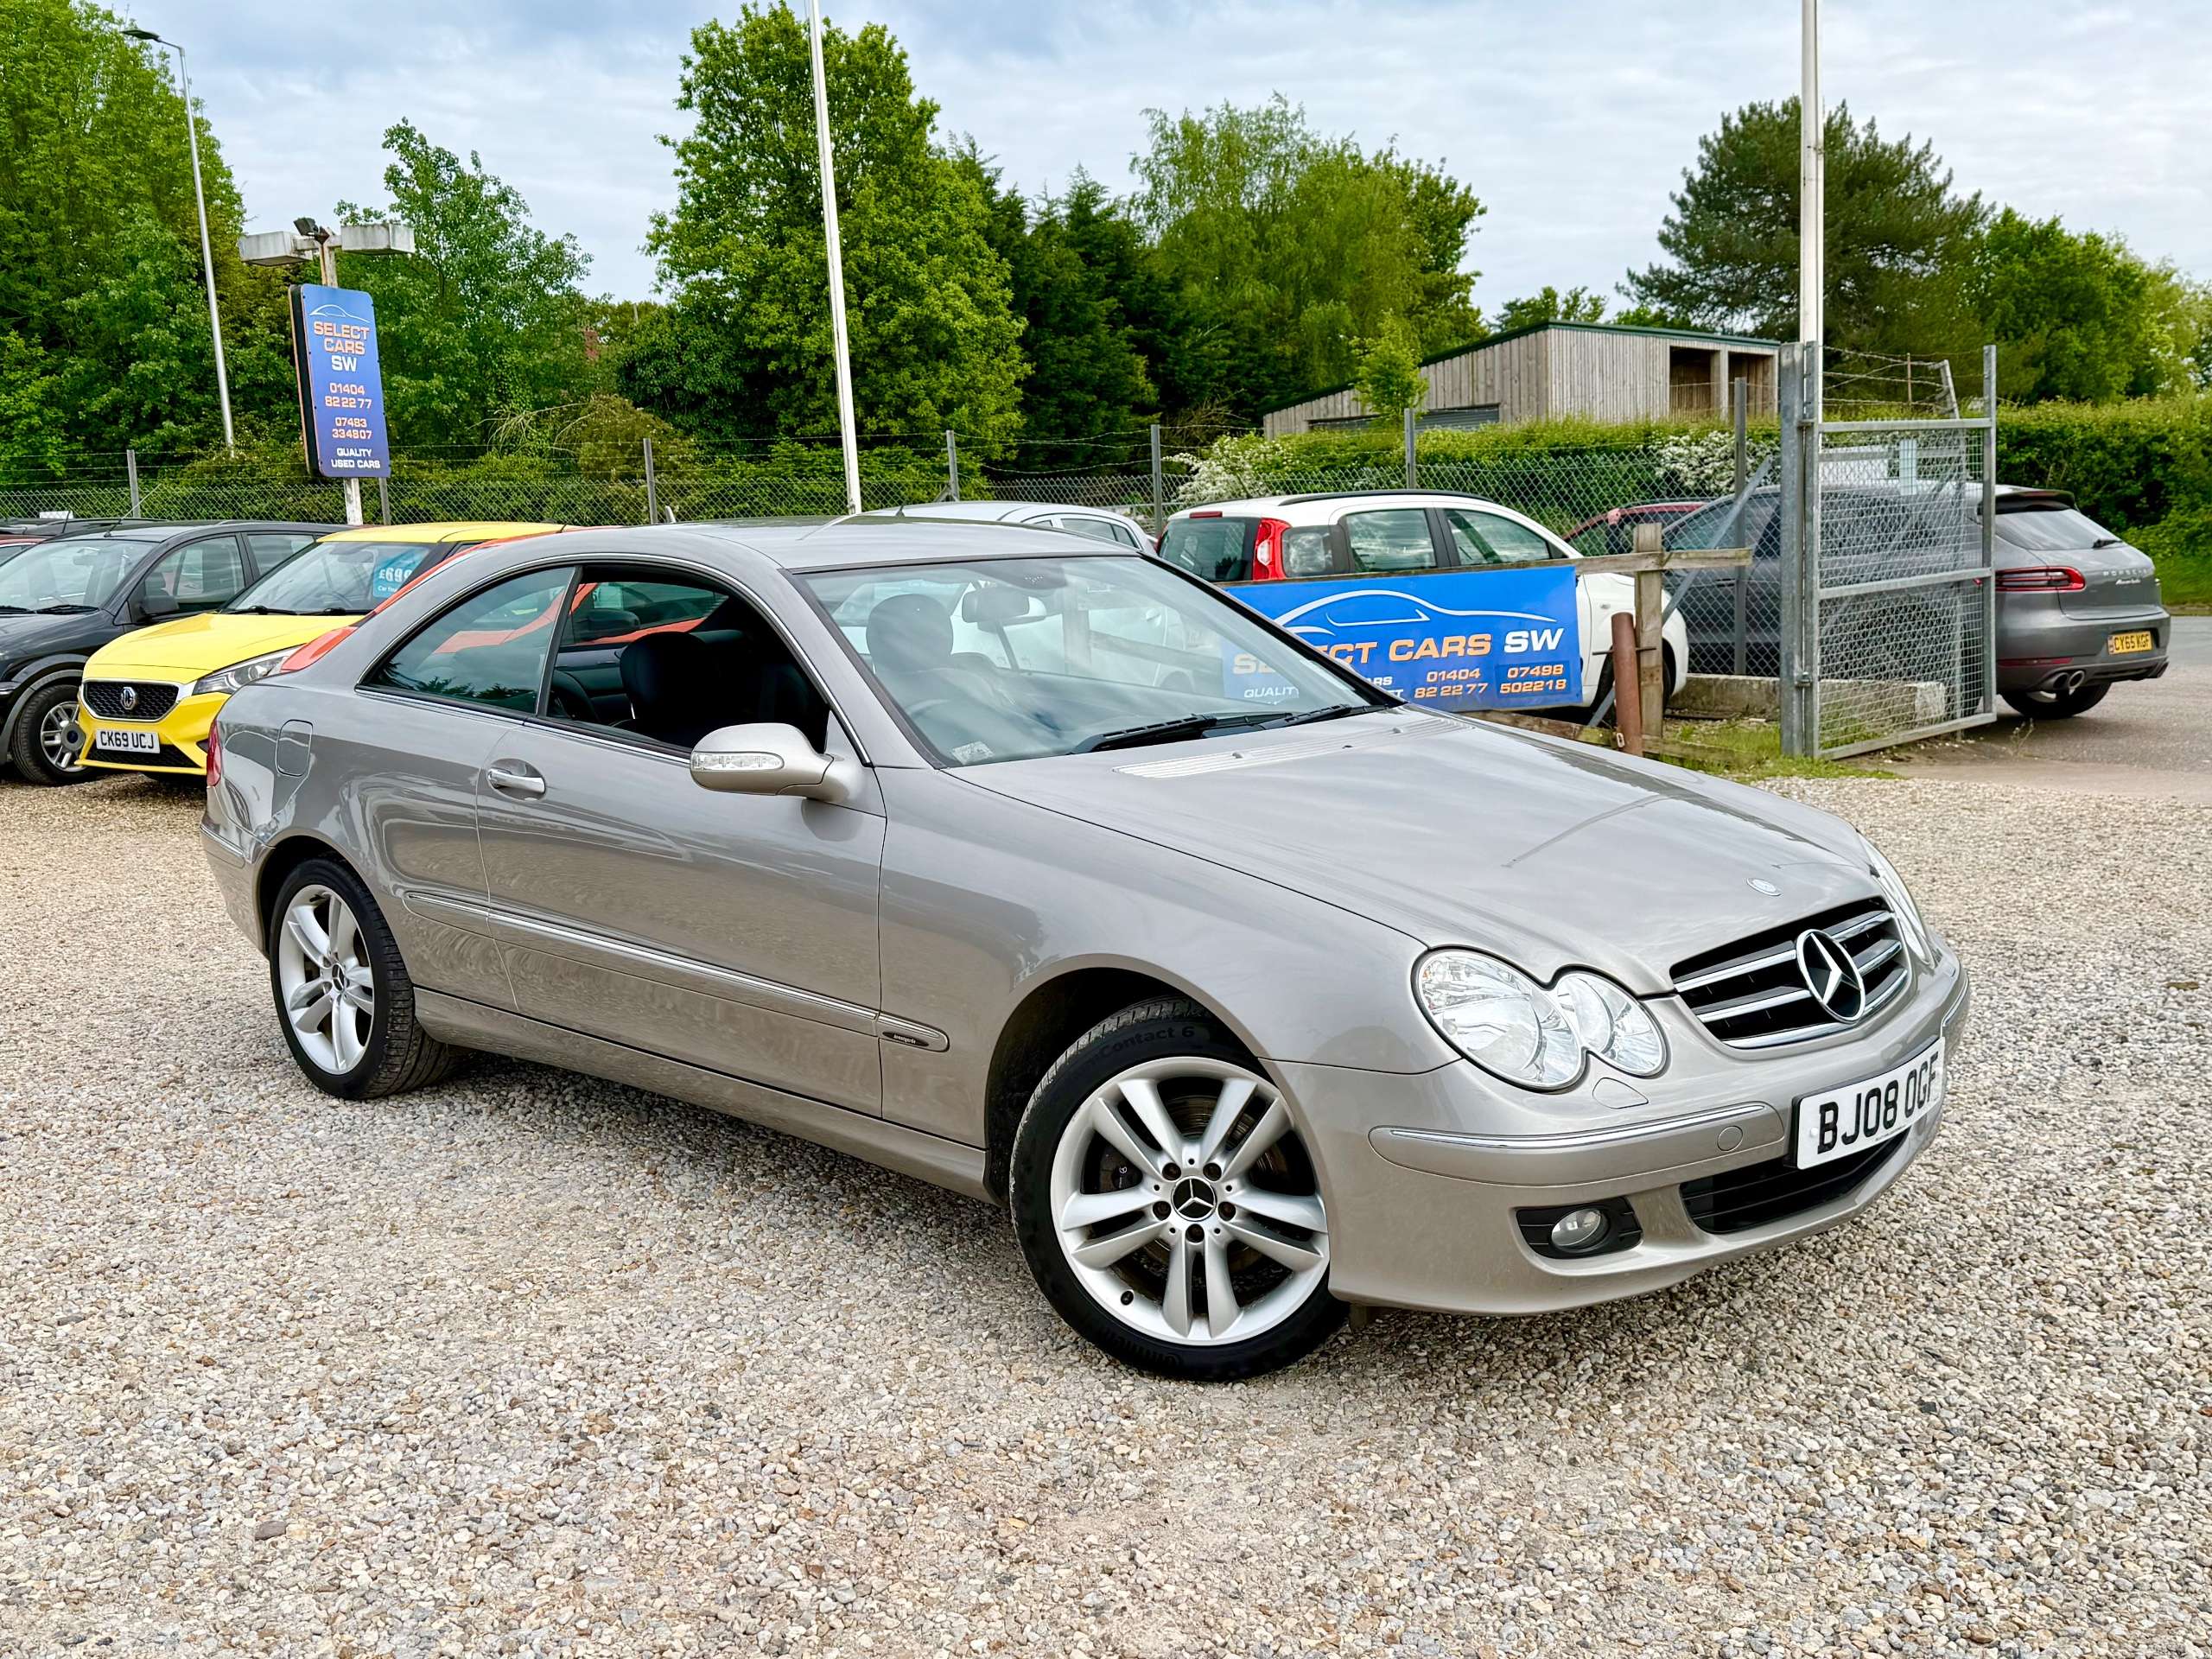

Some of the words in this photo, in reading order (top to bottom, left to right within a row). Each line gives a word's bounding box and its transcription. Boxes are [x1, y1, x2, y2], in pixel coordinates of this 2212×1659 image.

[314, 321, 370, 340] SELECT
[324, 338, 365, 355] CARS
[331, 354, 357, 372] SW
[329, 383, 365, 395] 01404
[325, 396, 340, 407] 82
[341, 397, 356, 408] 22
[358, 398, 372, 409] 77
[337, 448, 372, 457] QUALITY
[331, 459, 355, 467] USED
[357, 460, 381, 469] CARS
[1389, 633, 1492, 662] CARS
[1503, 627, 1565, 653] SW
[2113, 636, 2135, 651] CY65
[1427, 668, 1481, 683] 01404
[1414, 687, 1437, 699] 82
[1440, 684, 1464, 696] 22
[1466, 683, 1489, 695] 77
[1499, 678, 1567, 694] 502218
[100, 730, 130, 747] CK69
[131, 733, 155, 749] UCJ
[1181, 1025, 1195, 1038] 6
[1817, 1079, 1899, 1155] BJ08
[1904, 1051, 1939, 1118] OGF
